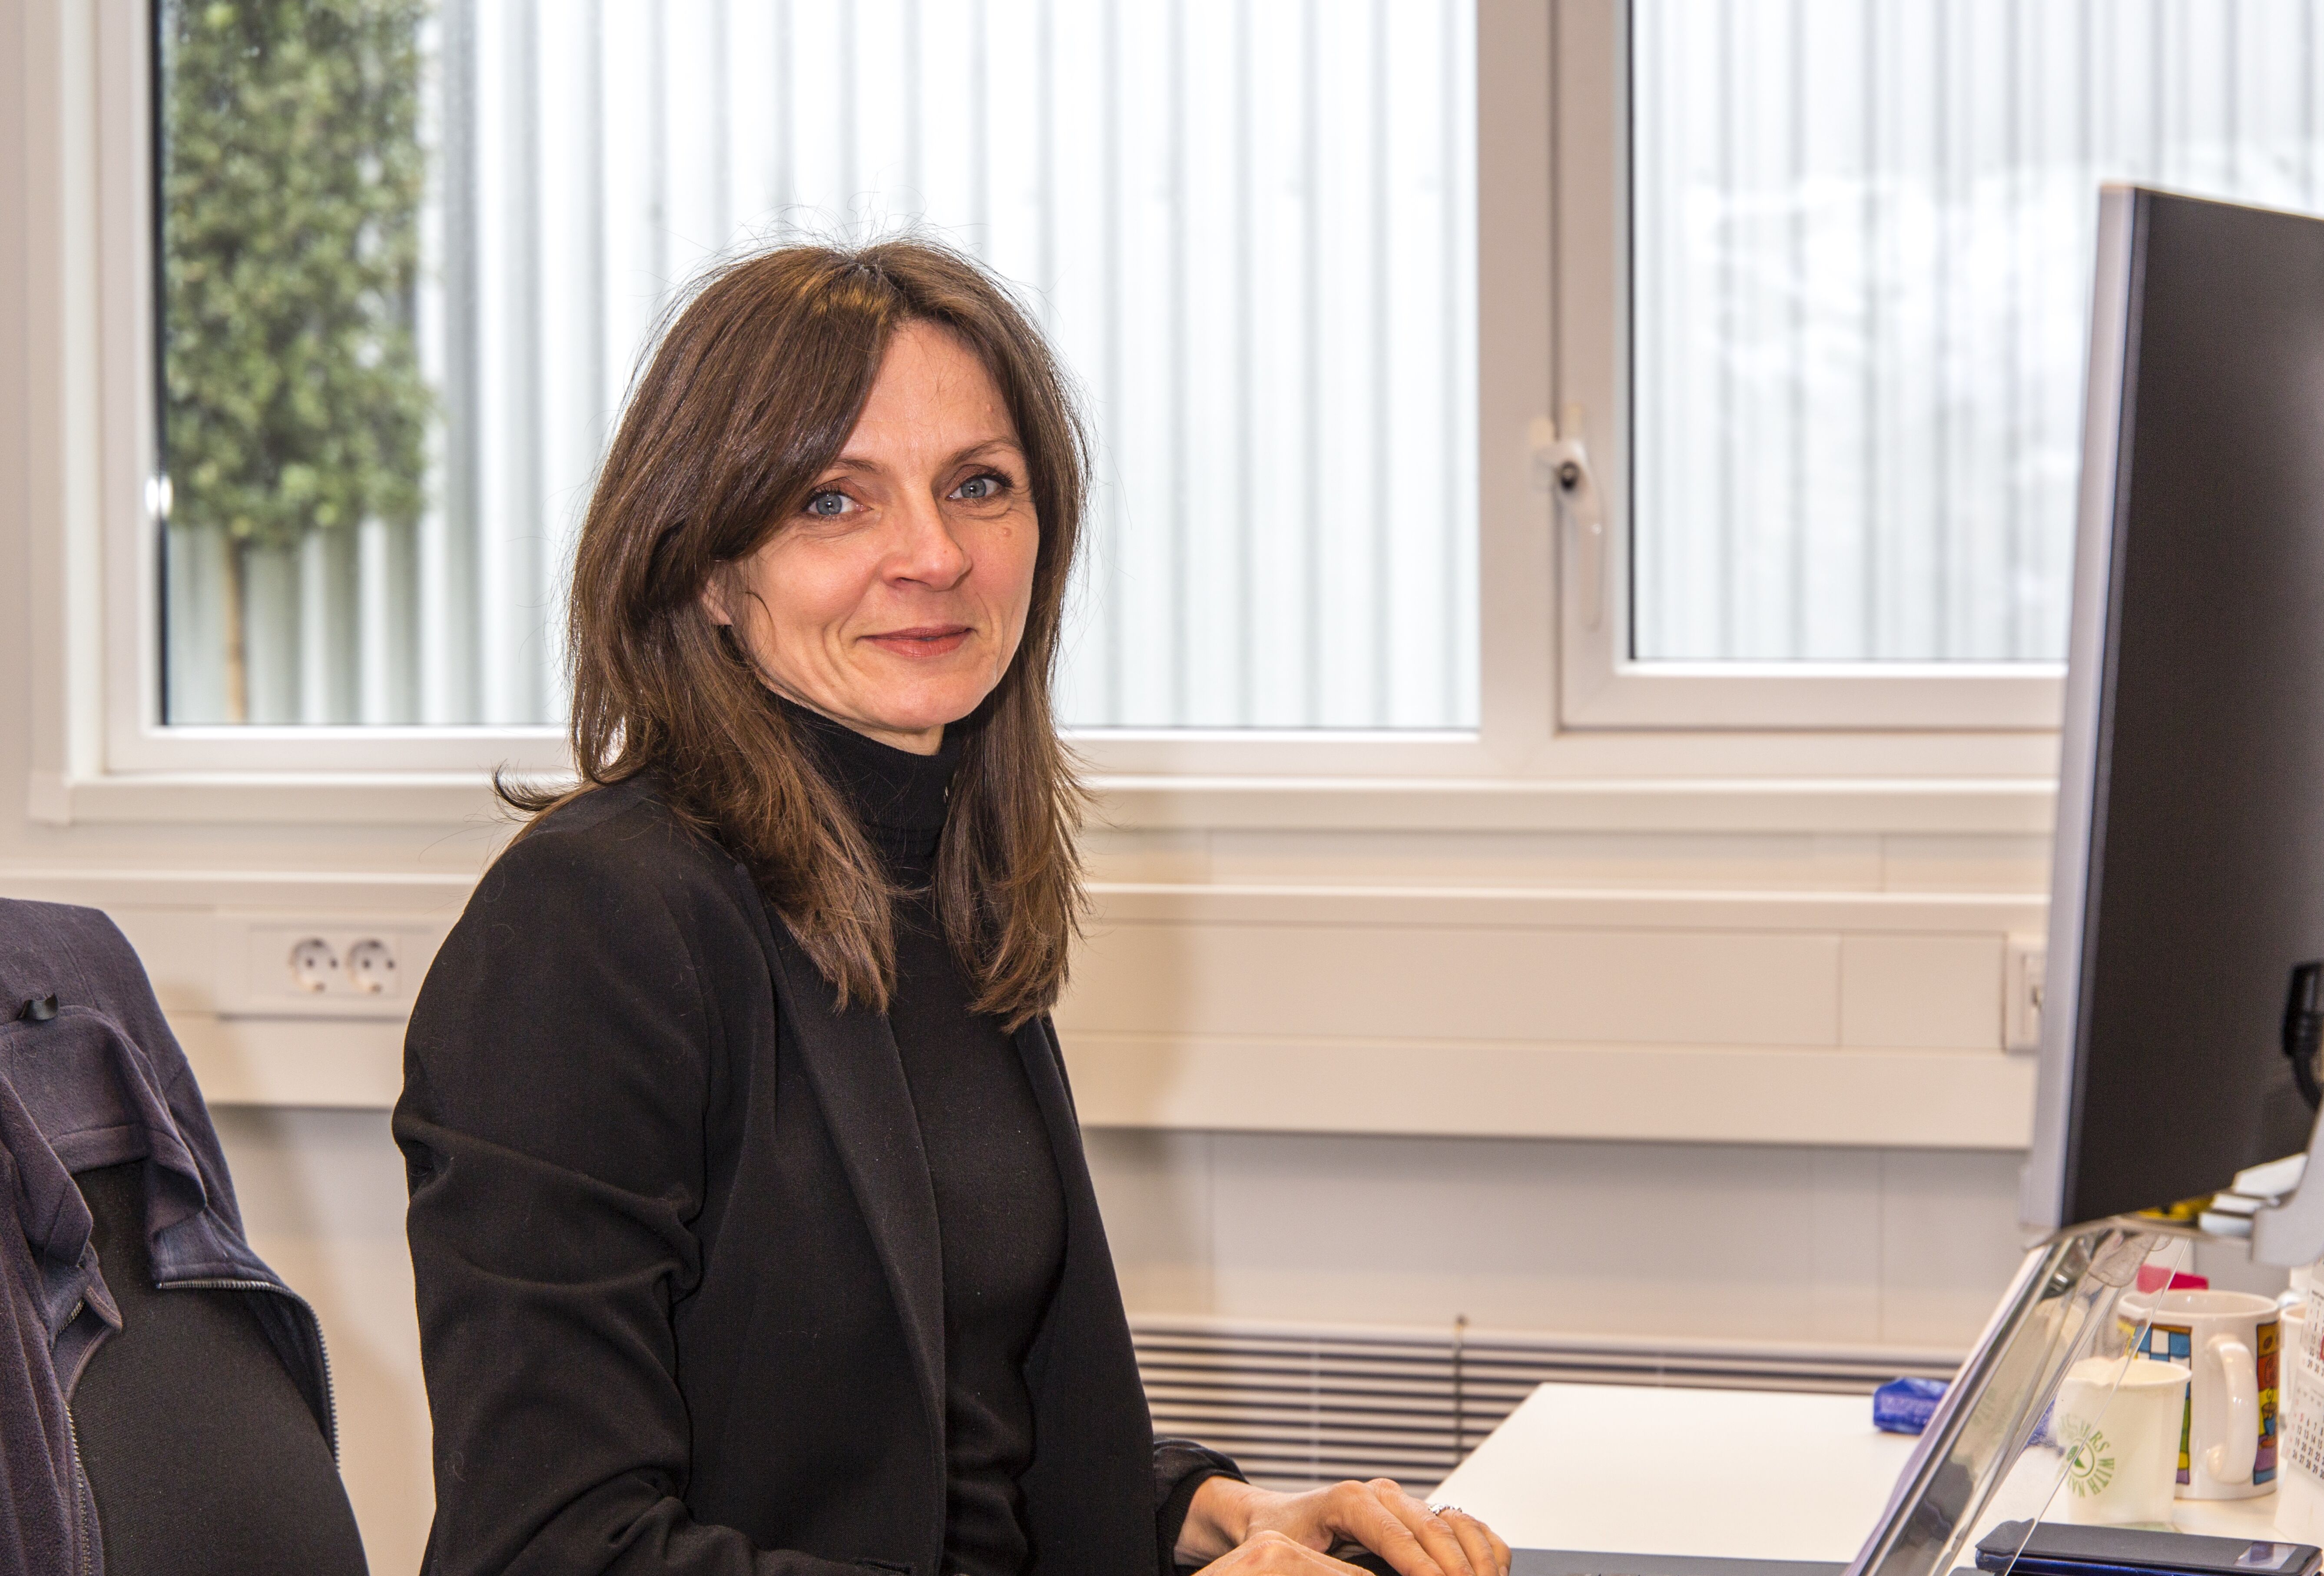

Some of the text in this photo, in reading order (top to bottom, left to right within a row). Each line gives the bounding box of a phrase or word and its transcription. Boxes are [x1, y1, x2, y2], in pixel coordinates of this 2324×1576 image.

[2295, 1437, 2300, 1447] 19
[2301, 1442, 2307, 1452] 20
[2308, 1447, 2313, 1457] 21
[2315, 1451, 2321, 1462] 22
[2297, 1425, 2302, 1435] 12
[2304, 1429, 2309, 1440] 13
[2311, 1434, 2316, 1445] 14
[2318, 1439, 2323, 1450] 15
[2292, 1449, 2297, 1460] 26
[2299, 1454, 2304, 1464] 27
[2306, 1459, 2311, 1470] 28
[2313, 1464, 2318, 1474] 29
[2086, 1458, 2115, 1495] WITH
